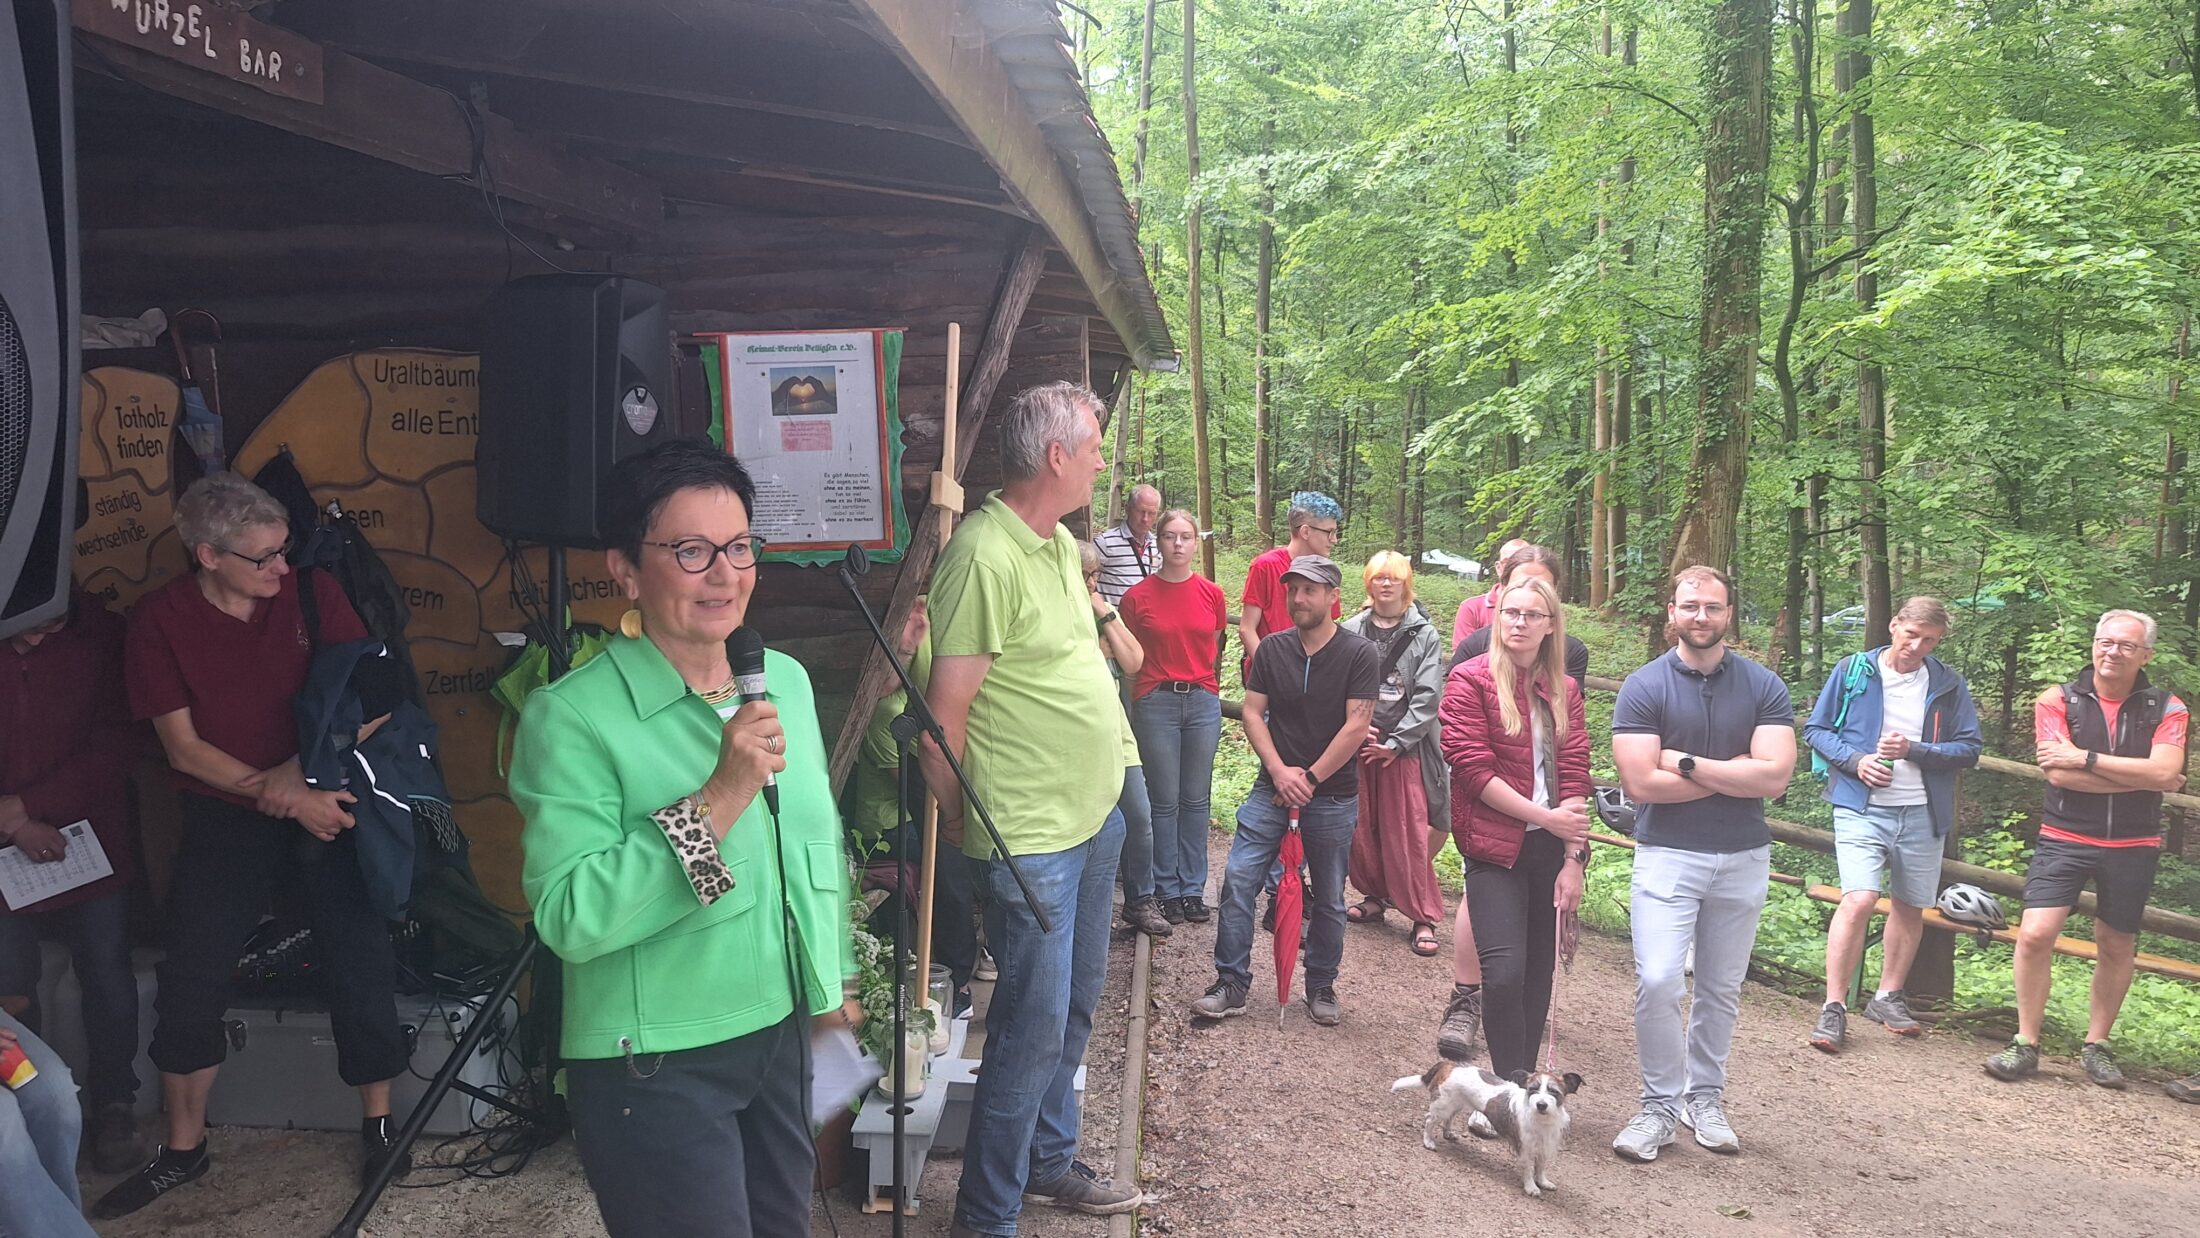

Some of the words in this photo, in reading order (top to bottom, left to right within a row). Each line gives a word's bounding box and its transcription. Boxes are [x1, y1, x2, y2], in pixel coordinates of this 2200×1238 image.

[239, 38, 282, 82] BAR
[374, 358, 480, 388] Uraltbäum
[114, 403, 168, 430] Totholz
[391, 408, 433, 435] alle
[116, 433, 164, 459] finden
[95, 489, 142, 517] ständig
[75, 523, 149, 558] wechselnde
